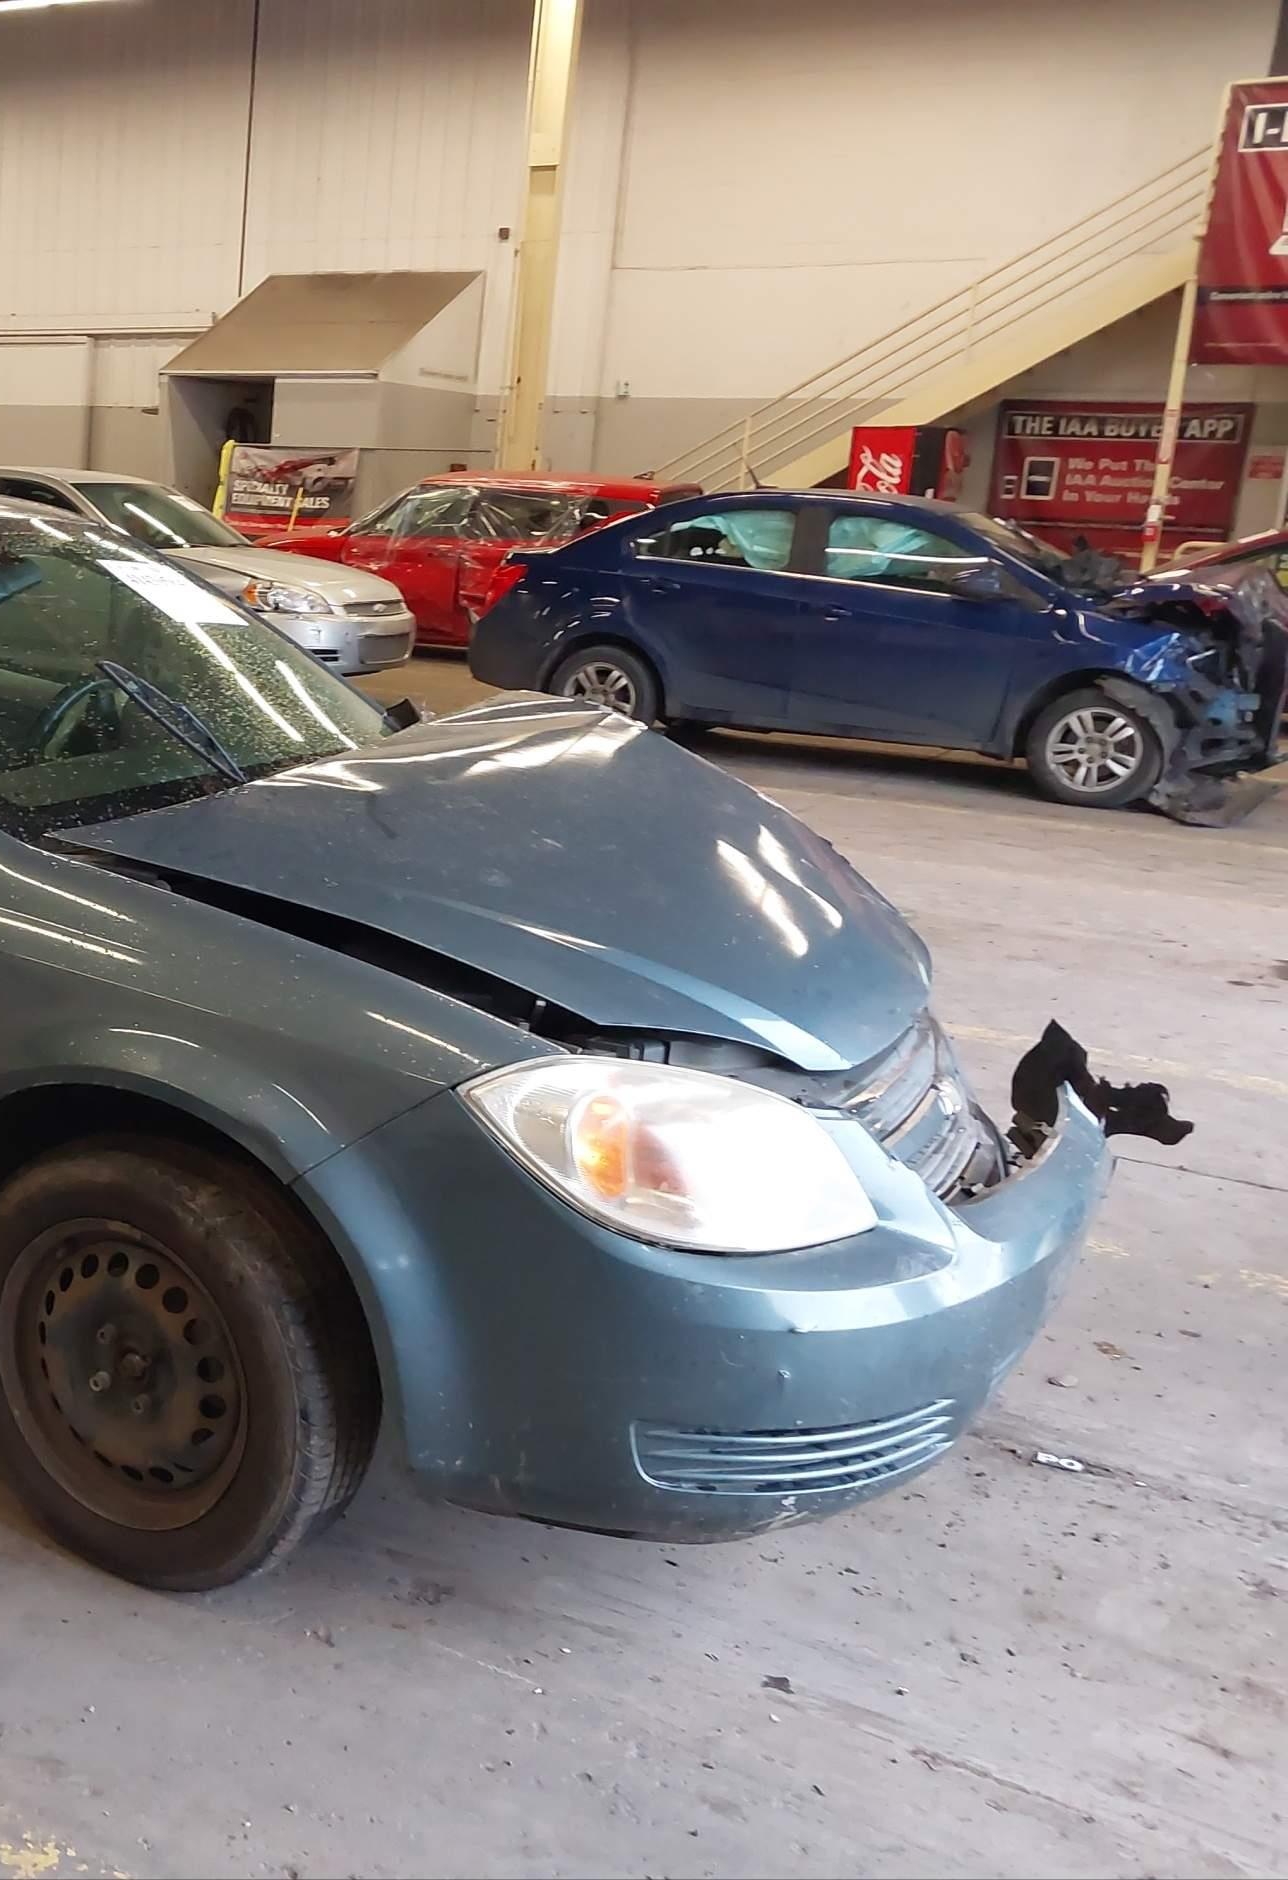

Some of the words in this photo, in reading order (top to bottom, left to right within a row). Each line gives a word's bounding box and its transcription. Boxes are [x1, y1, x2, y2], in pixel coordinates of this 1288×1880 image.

[1013, 415, 1054, 435] THE
[1058, 417, 1098, 436] IAA
[1184, 418, 1233, 438] APP
